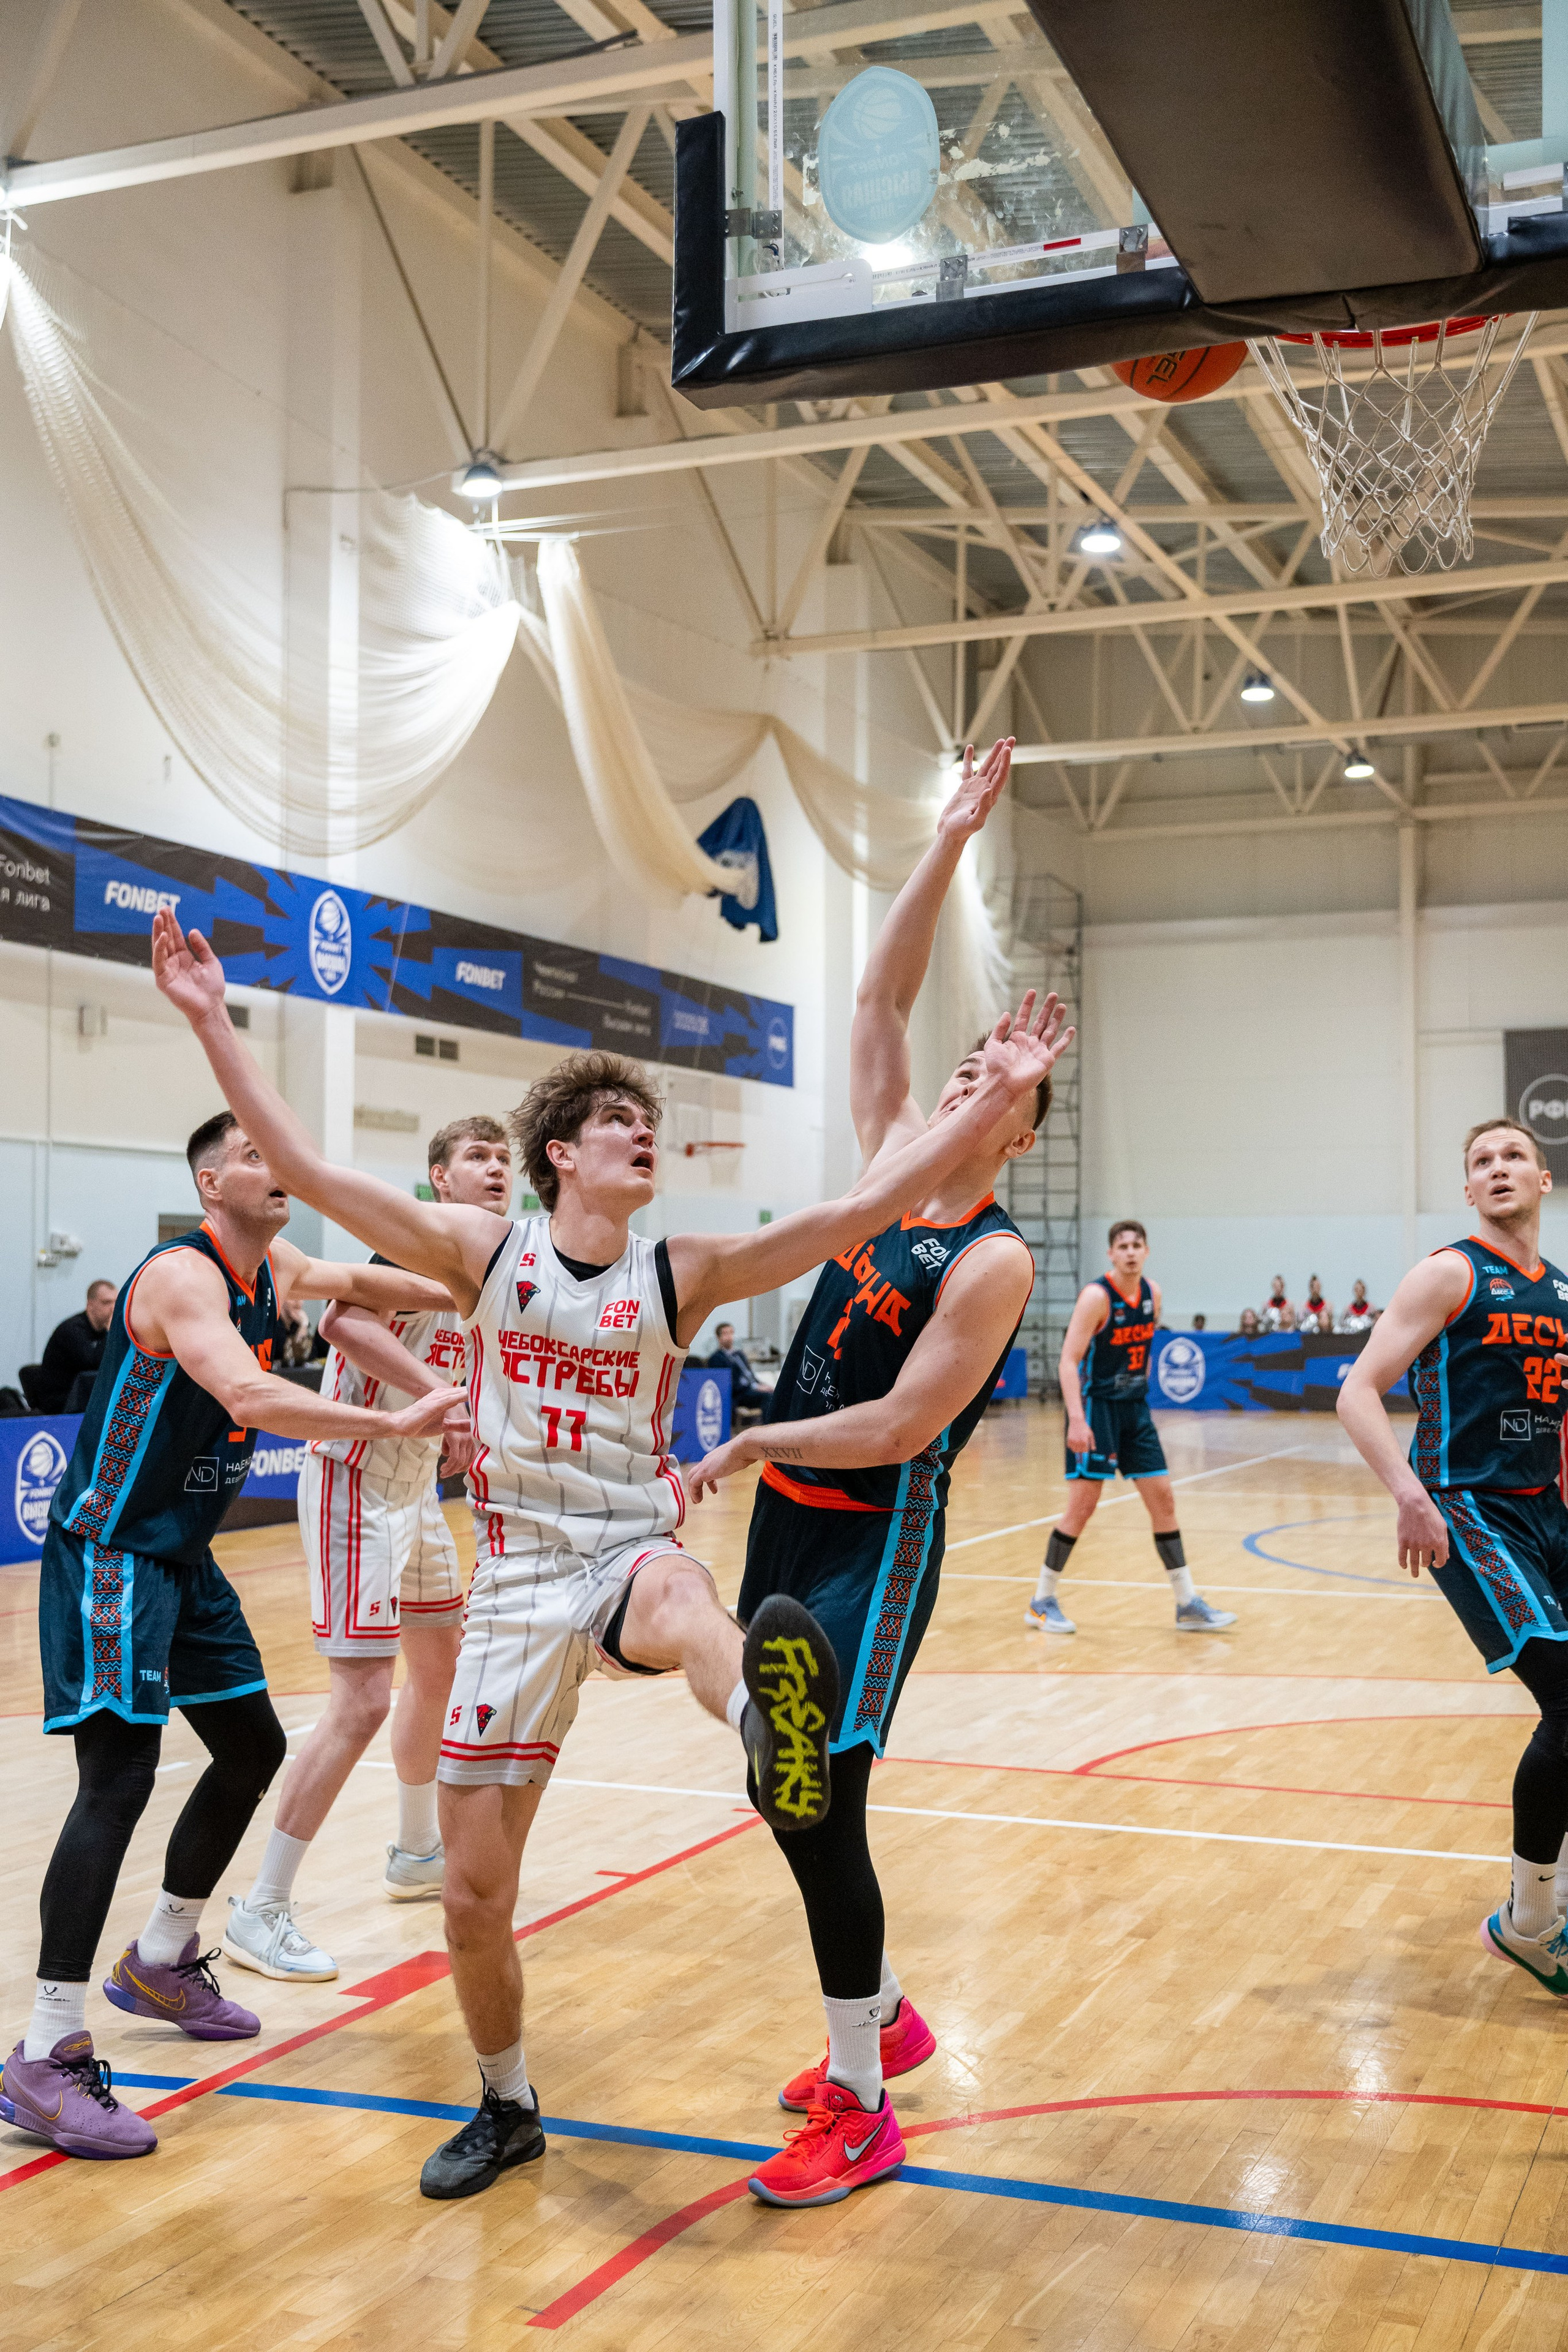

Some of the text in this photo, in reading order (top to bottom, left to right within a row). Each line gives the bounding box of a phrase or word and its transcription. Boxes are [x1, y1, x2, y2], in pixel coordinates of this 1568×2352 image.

[105, 880, 181, 914] FONBET
[911, 1243, 942, 1270] BET
[1482, 1265, 1508, 1275] TEAM
[599, 1314, 637, 1329] BET
[603, 1299, 640, 1314] FON
[498, 1329, 641, 1368] ЧЕБОКСАРСКИЕ
[500, 1349, 640, 1398] ЯСТРЕБЫ
[1523, 1356, 1562, 1404] 22
[541, 1405, 587, 1452] 77
[139, 1669, 162, 1683] TEAM
